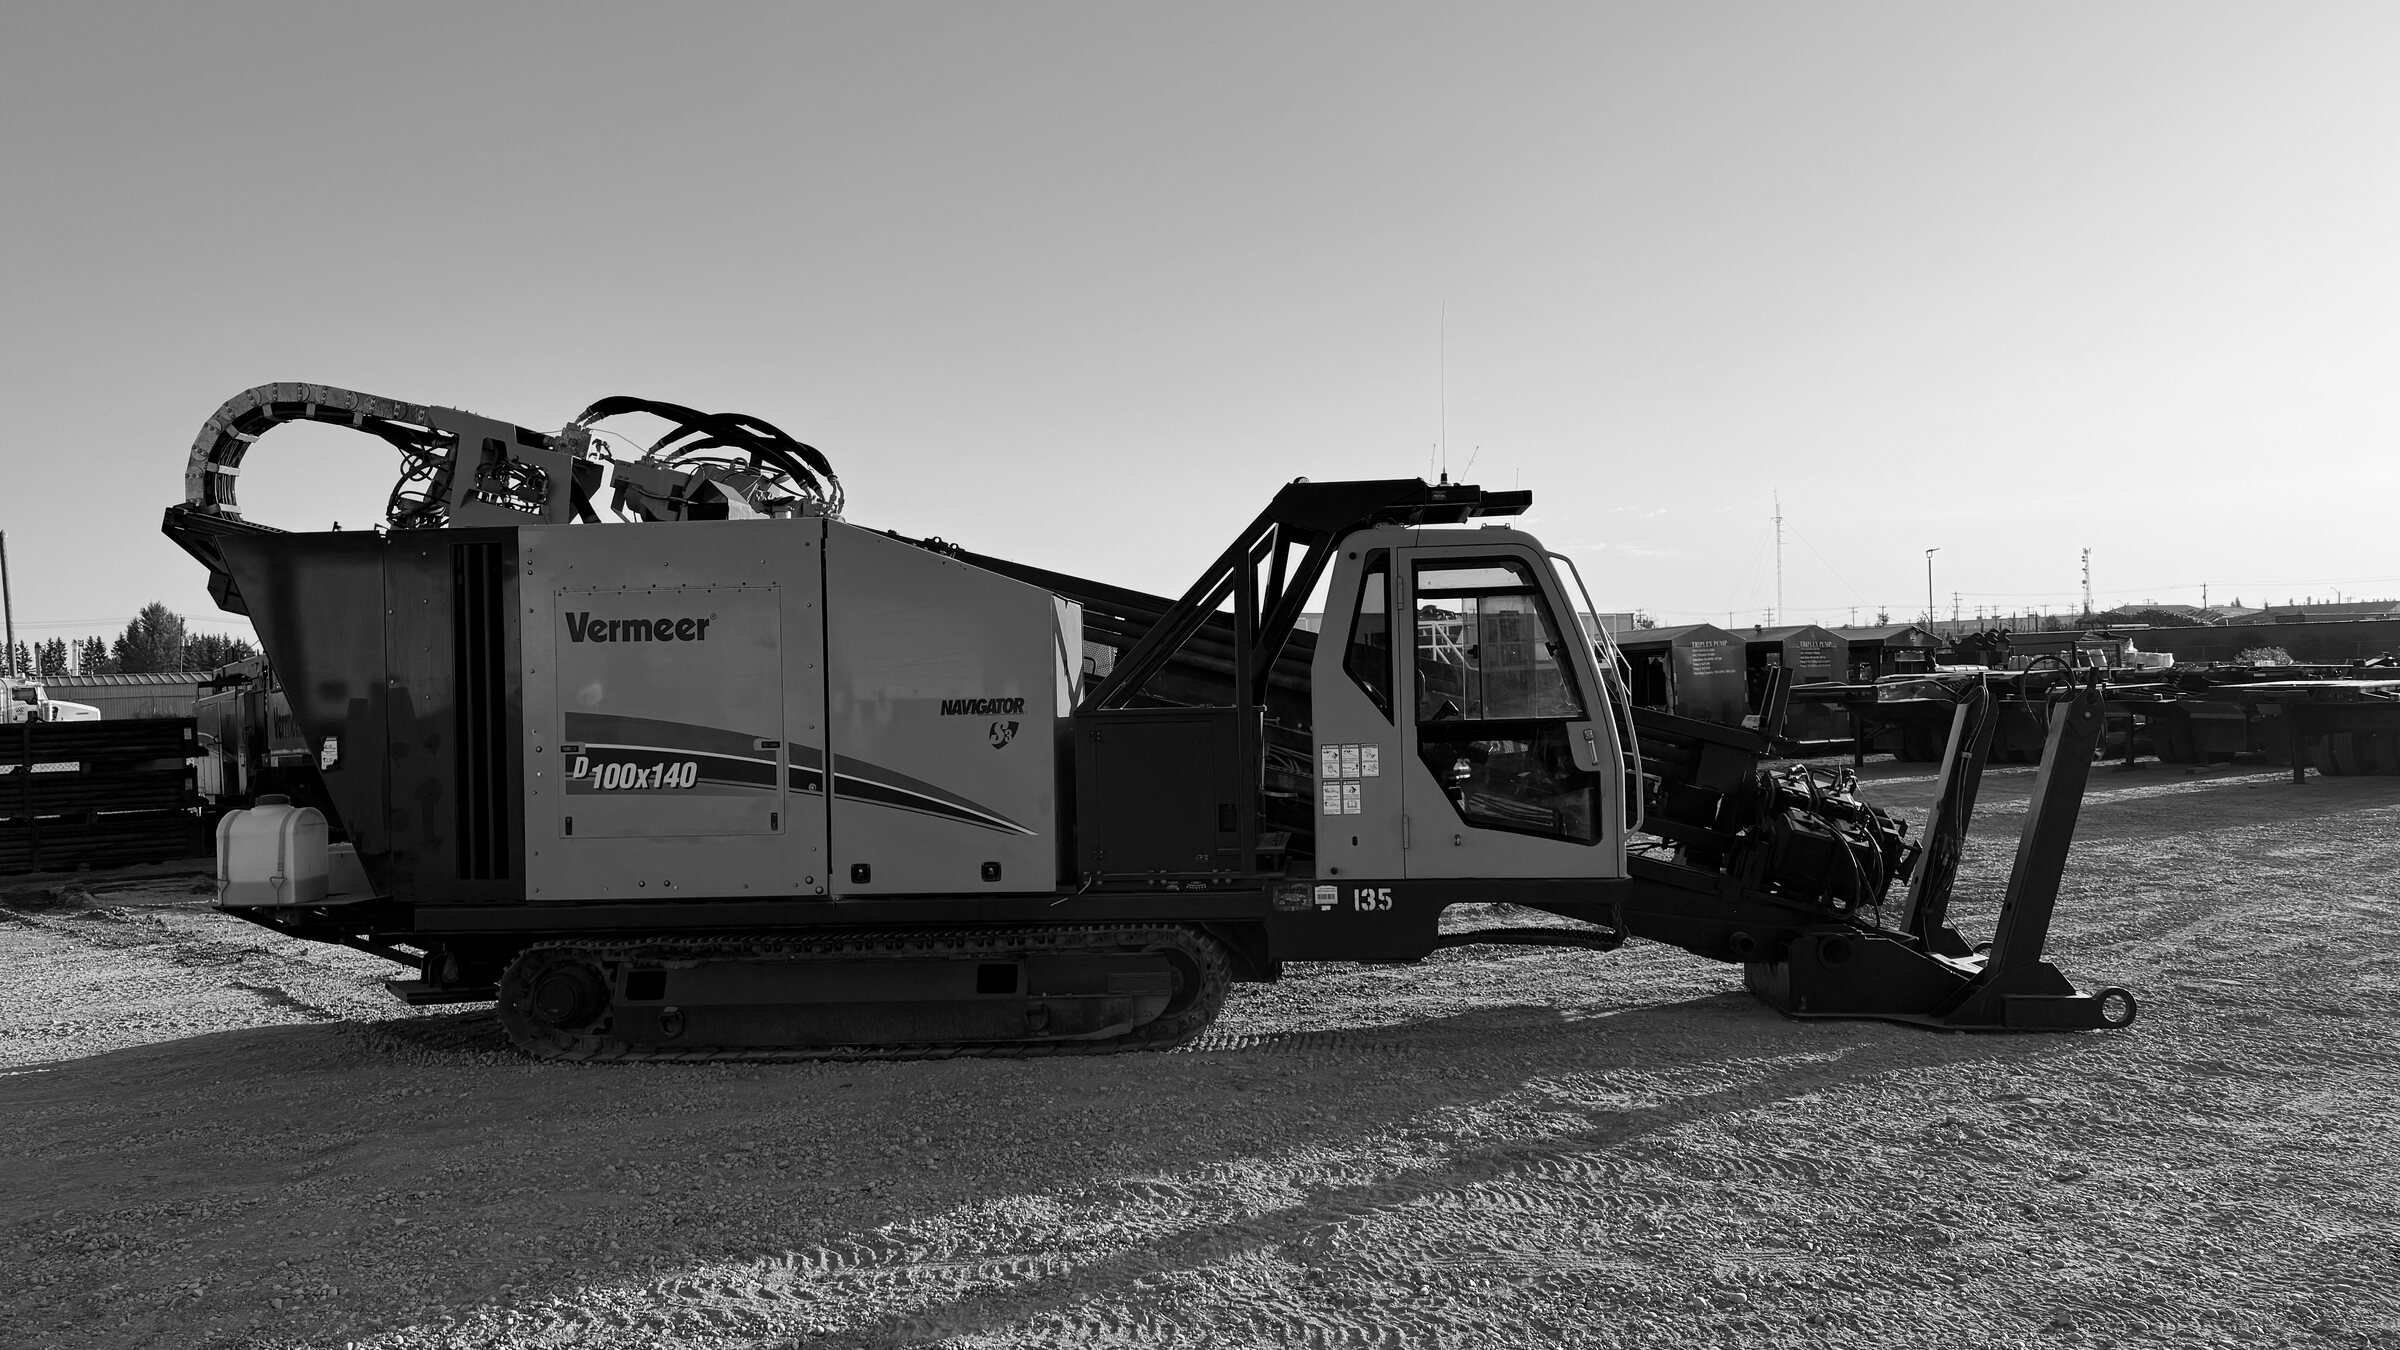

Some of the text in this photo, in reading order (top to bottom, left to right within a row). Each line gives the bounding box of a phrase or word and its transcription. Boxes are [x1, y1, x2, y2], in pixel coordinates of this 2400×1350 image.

[941, 698, 1025, 716] NAVIGATOR
[274, 706, 303, 739] Vermee
[1354, 888, 1393, 911] 135
